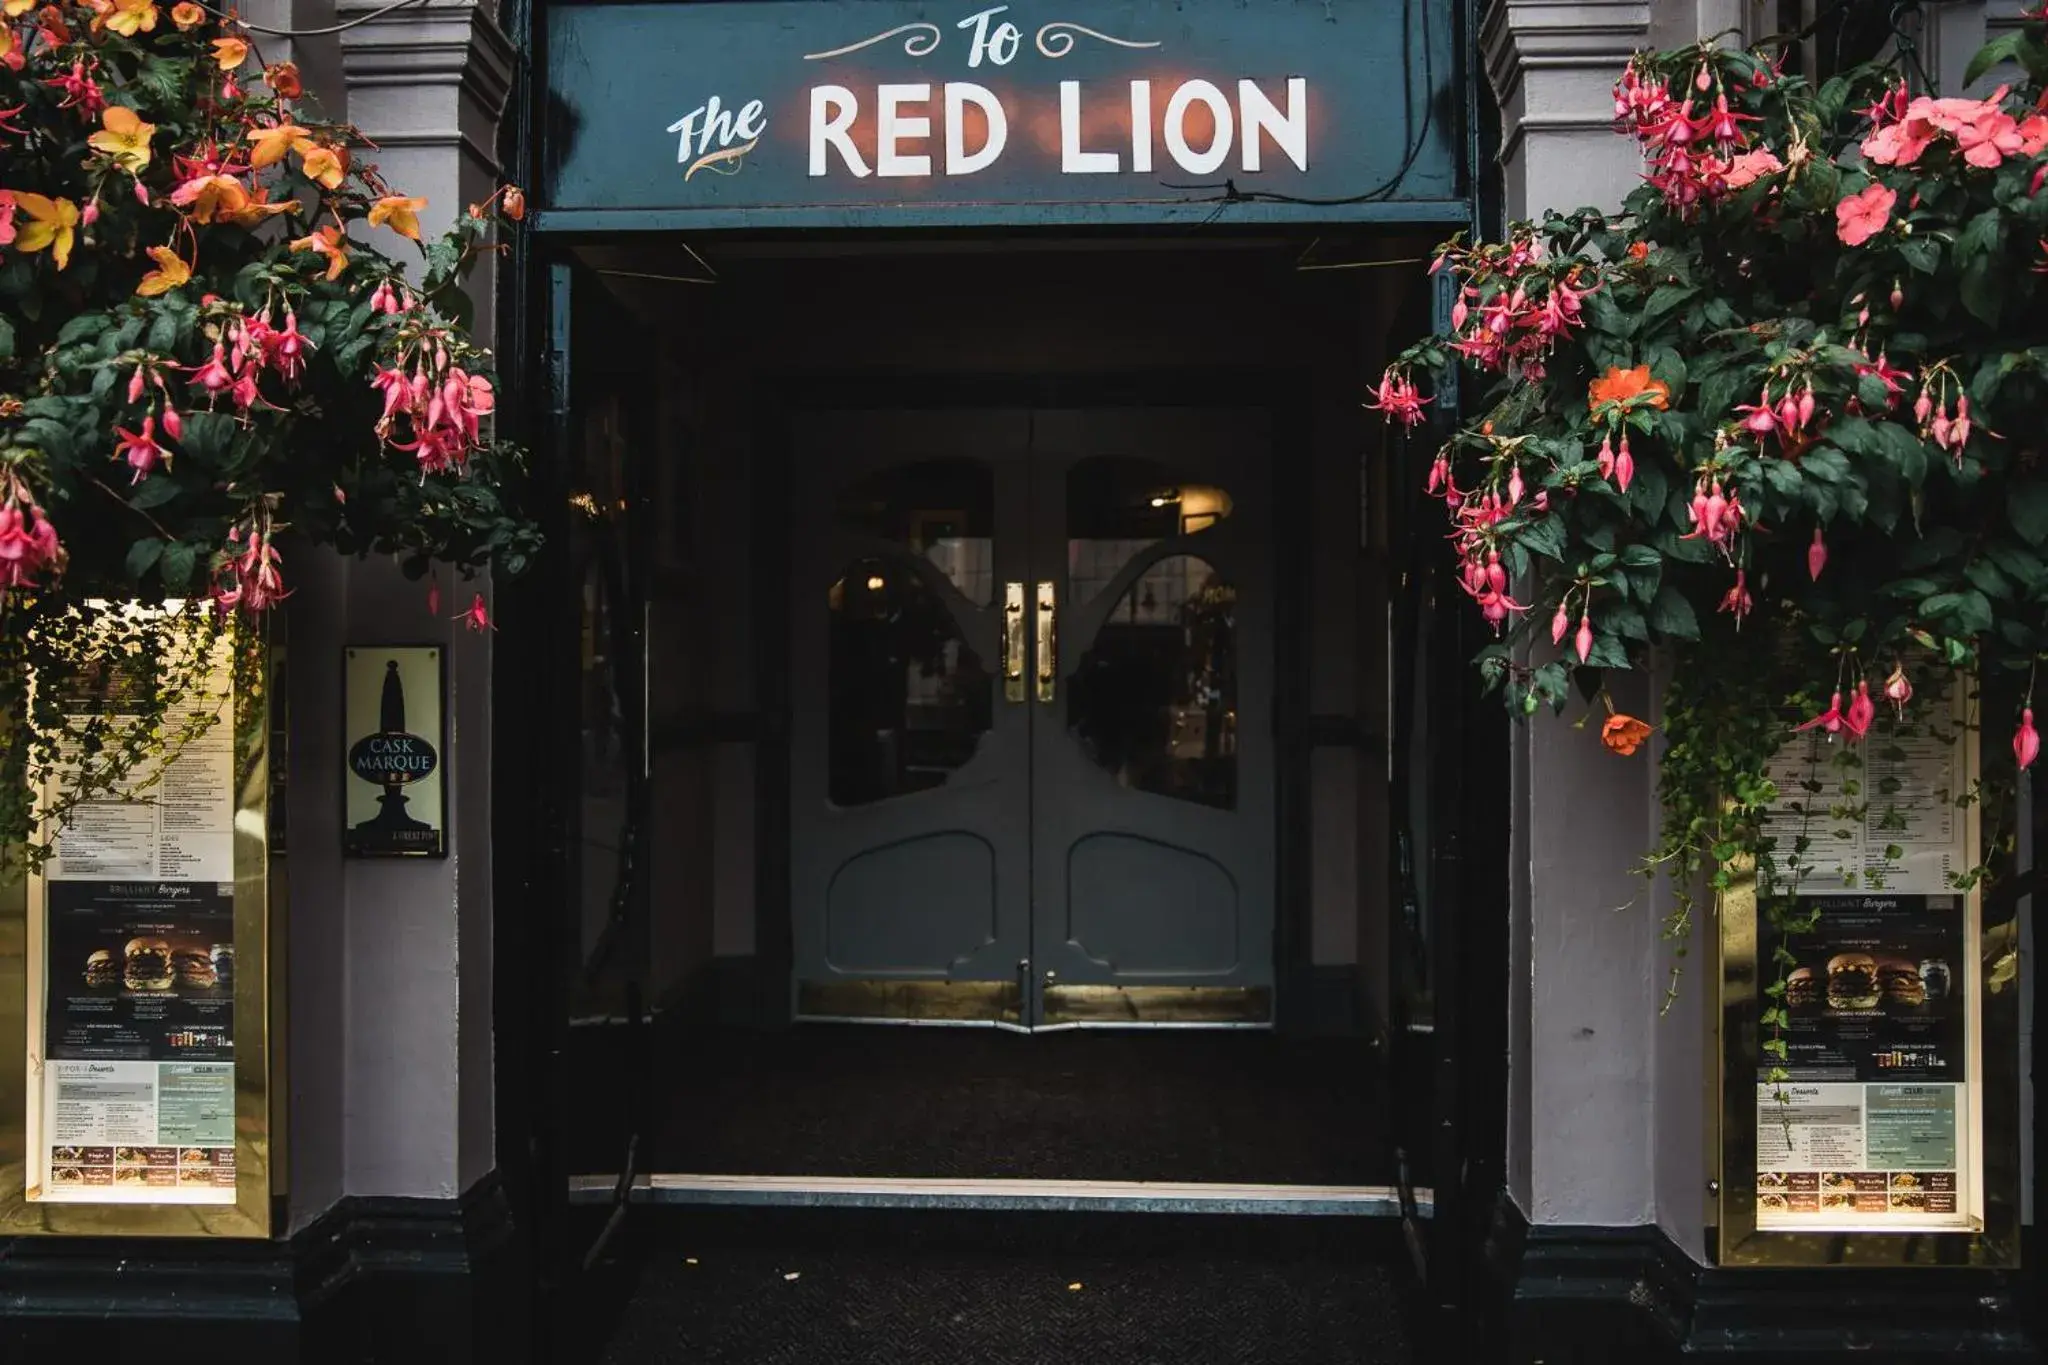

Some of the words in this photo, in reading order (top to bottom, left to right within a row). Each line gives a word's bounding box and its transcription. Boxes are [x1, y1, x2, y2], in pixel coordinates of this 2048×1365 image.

[957, 5, 1023, 68] To
[666, 96, 768, 165] The
[809, 81, 1008, 179] RED
[1060, 78, 1309, 176] LION
[356, 754, 431, 771] MARQUE
[370, 739, 415, 754] CASK
